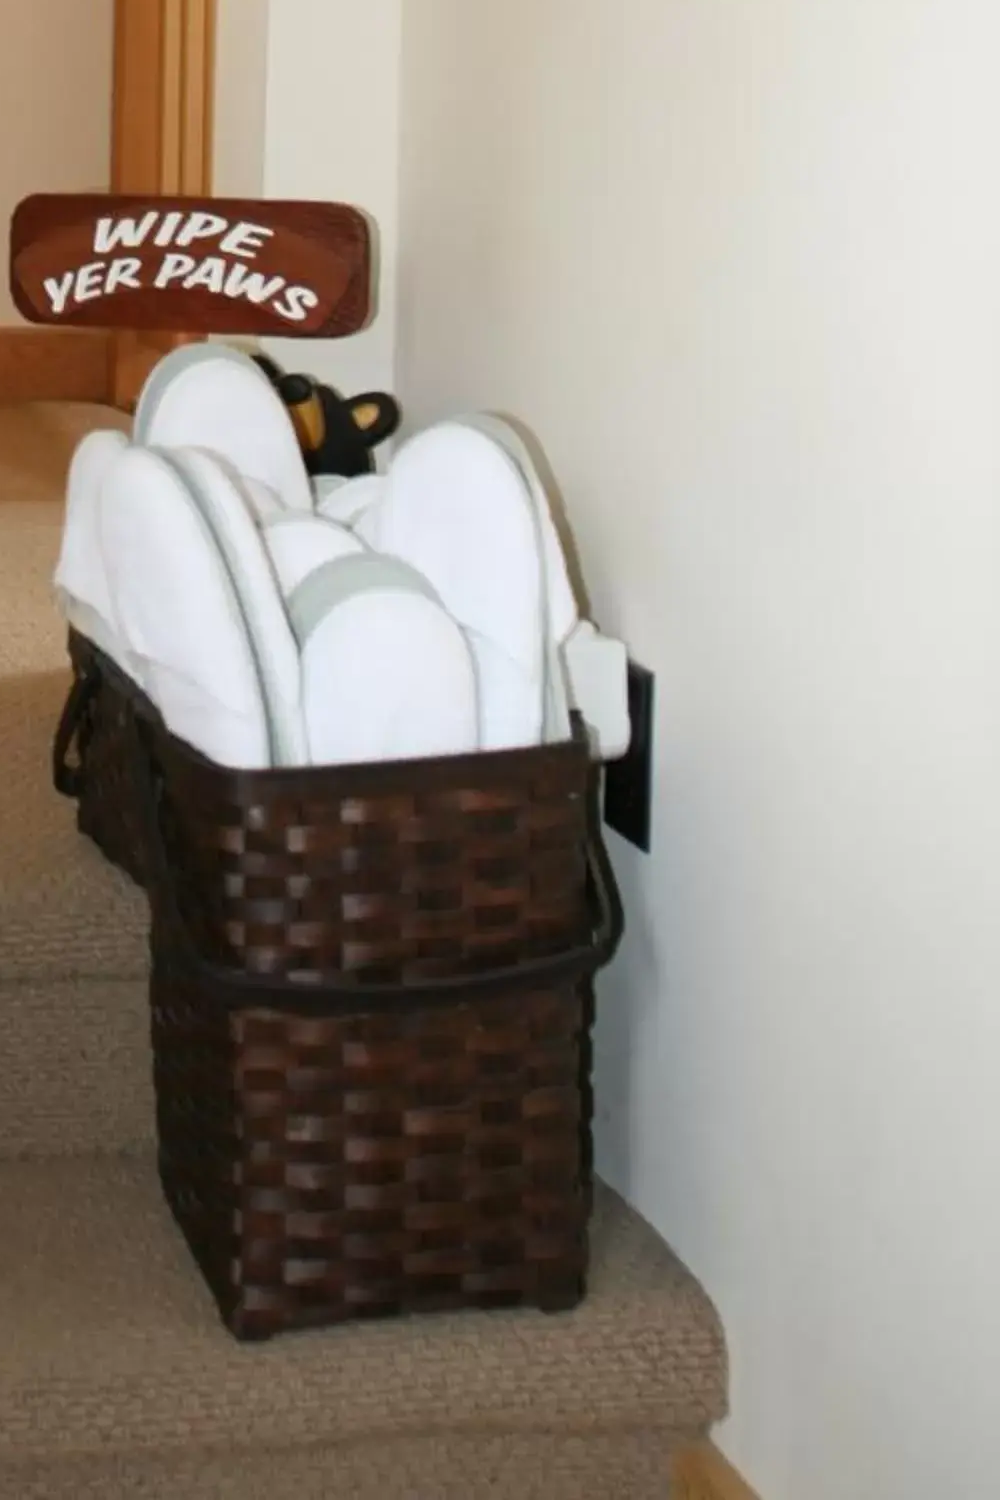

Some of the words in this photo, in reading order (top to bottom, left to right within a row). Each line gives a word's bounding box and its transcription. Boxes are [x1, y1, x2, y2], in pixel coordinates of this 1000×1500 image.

[93, 210, 275, 259] WIPE
[43, 257, 142, 315] YER
[153, 253, 319, 322] PAWS
